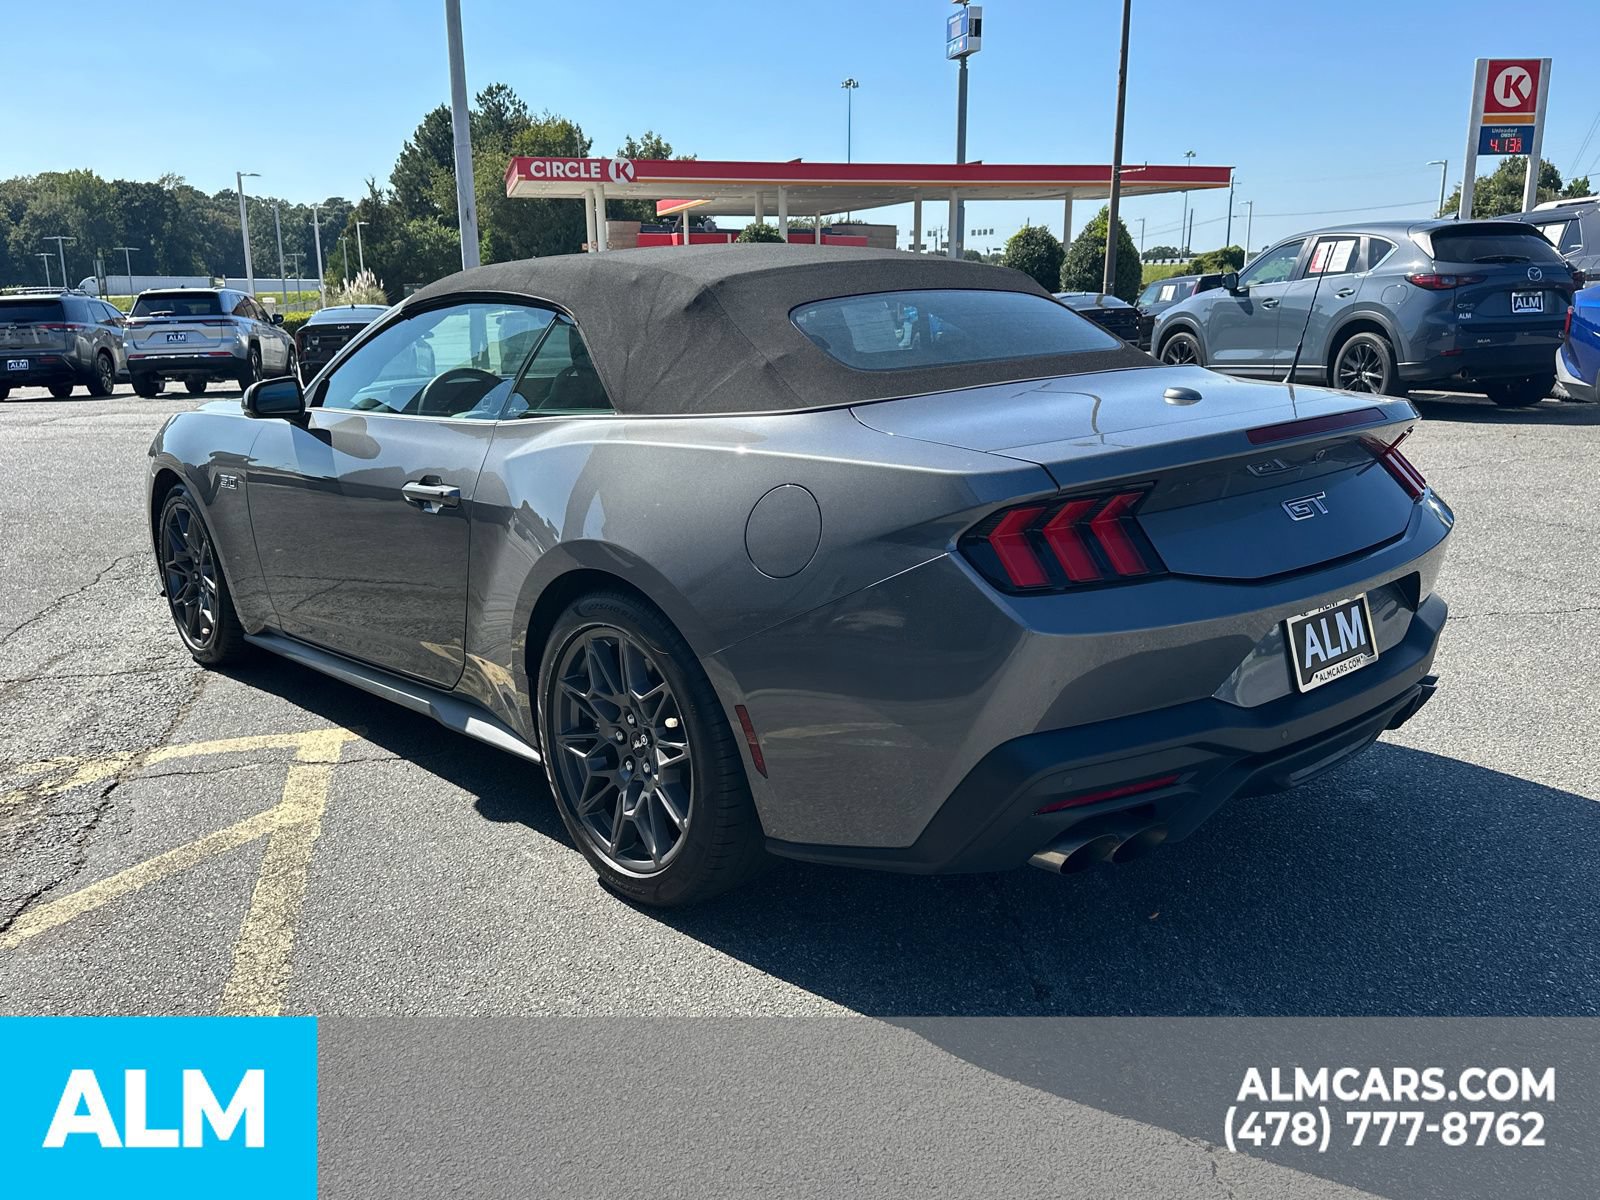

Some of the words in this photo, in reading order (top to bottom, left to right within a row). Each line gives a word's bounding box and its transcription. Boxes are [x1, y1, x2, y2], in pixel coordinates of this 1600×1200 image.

[1503, 74, 1527, 104] K
[530, 161, 601, 178] CIRCLE
[613, 160, 634, 183] K
[1515, 297, 1540, 308] ALM
[10, 361, 27, 369] ALM
[1281, 491, 1328, 521] GT
[1305, 605, 1366, 669] ALM
[1319, 656, 1362, 682] ALMCARS.COM
